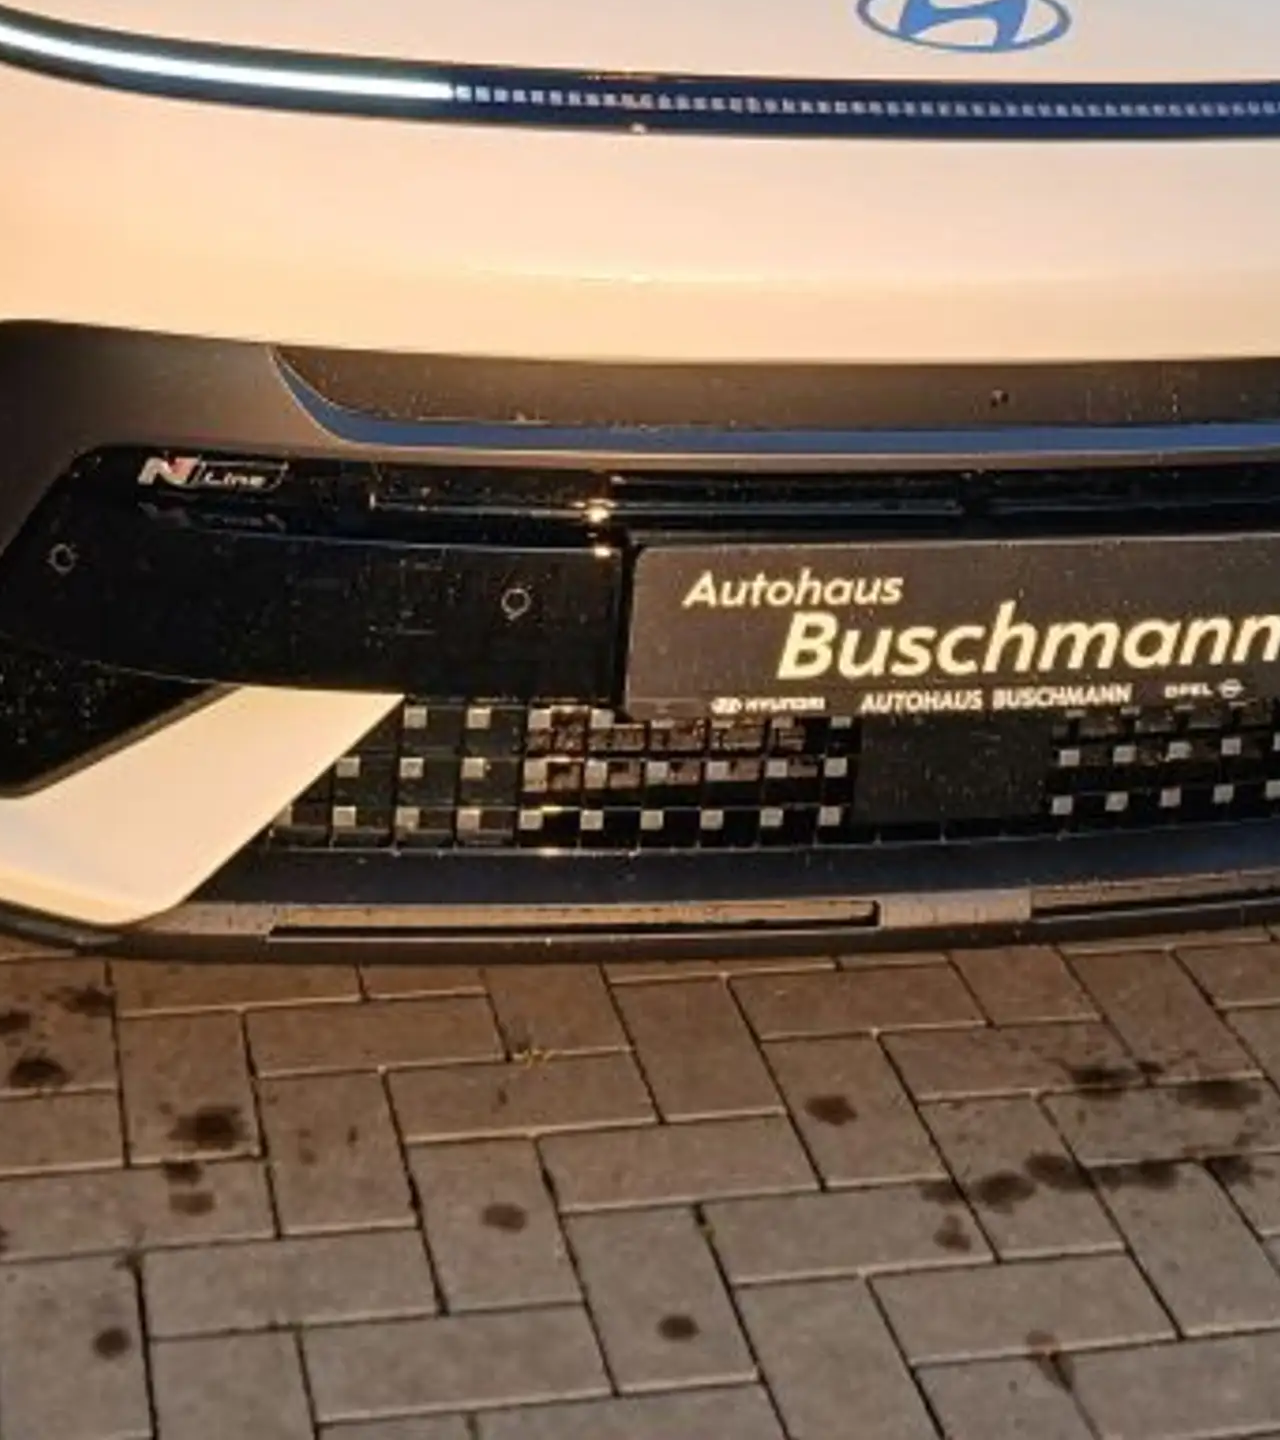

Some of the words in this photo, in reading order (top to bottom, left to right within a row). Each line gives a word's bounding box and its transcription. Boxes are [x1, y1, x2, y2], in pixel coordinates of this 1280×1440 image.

[137, 457, 200, 486] N
[682, 566, 904, 608] Autohaus
[860, 688, 984, 715] AUTOHAUS
[992, 682, 1133, 710] BUSCHMANN
